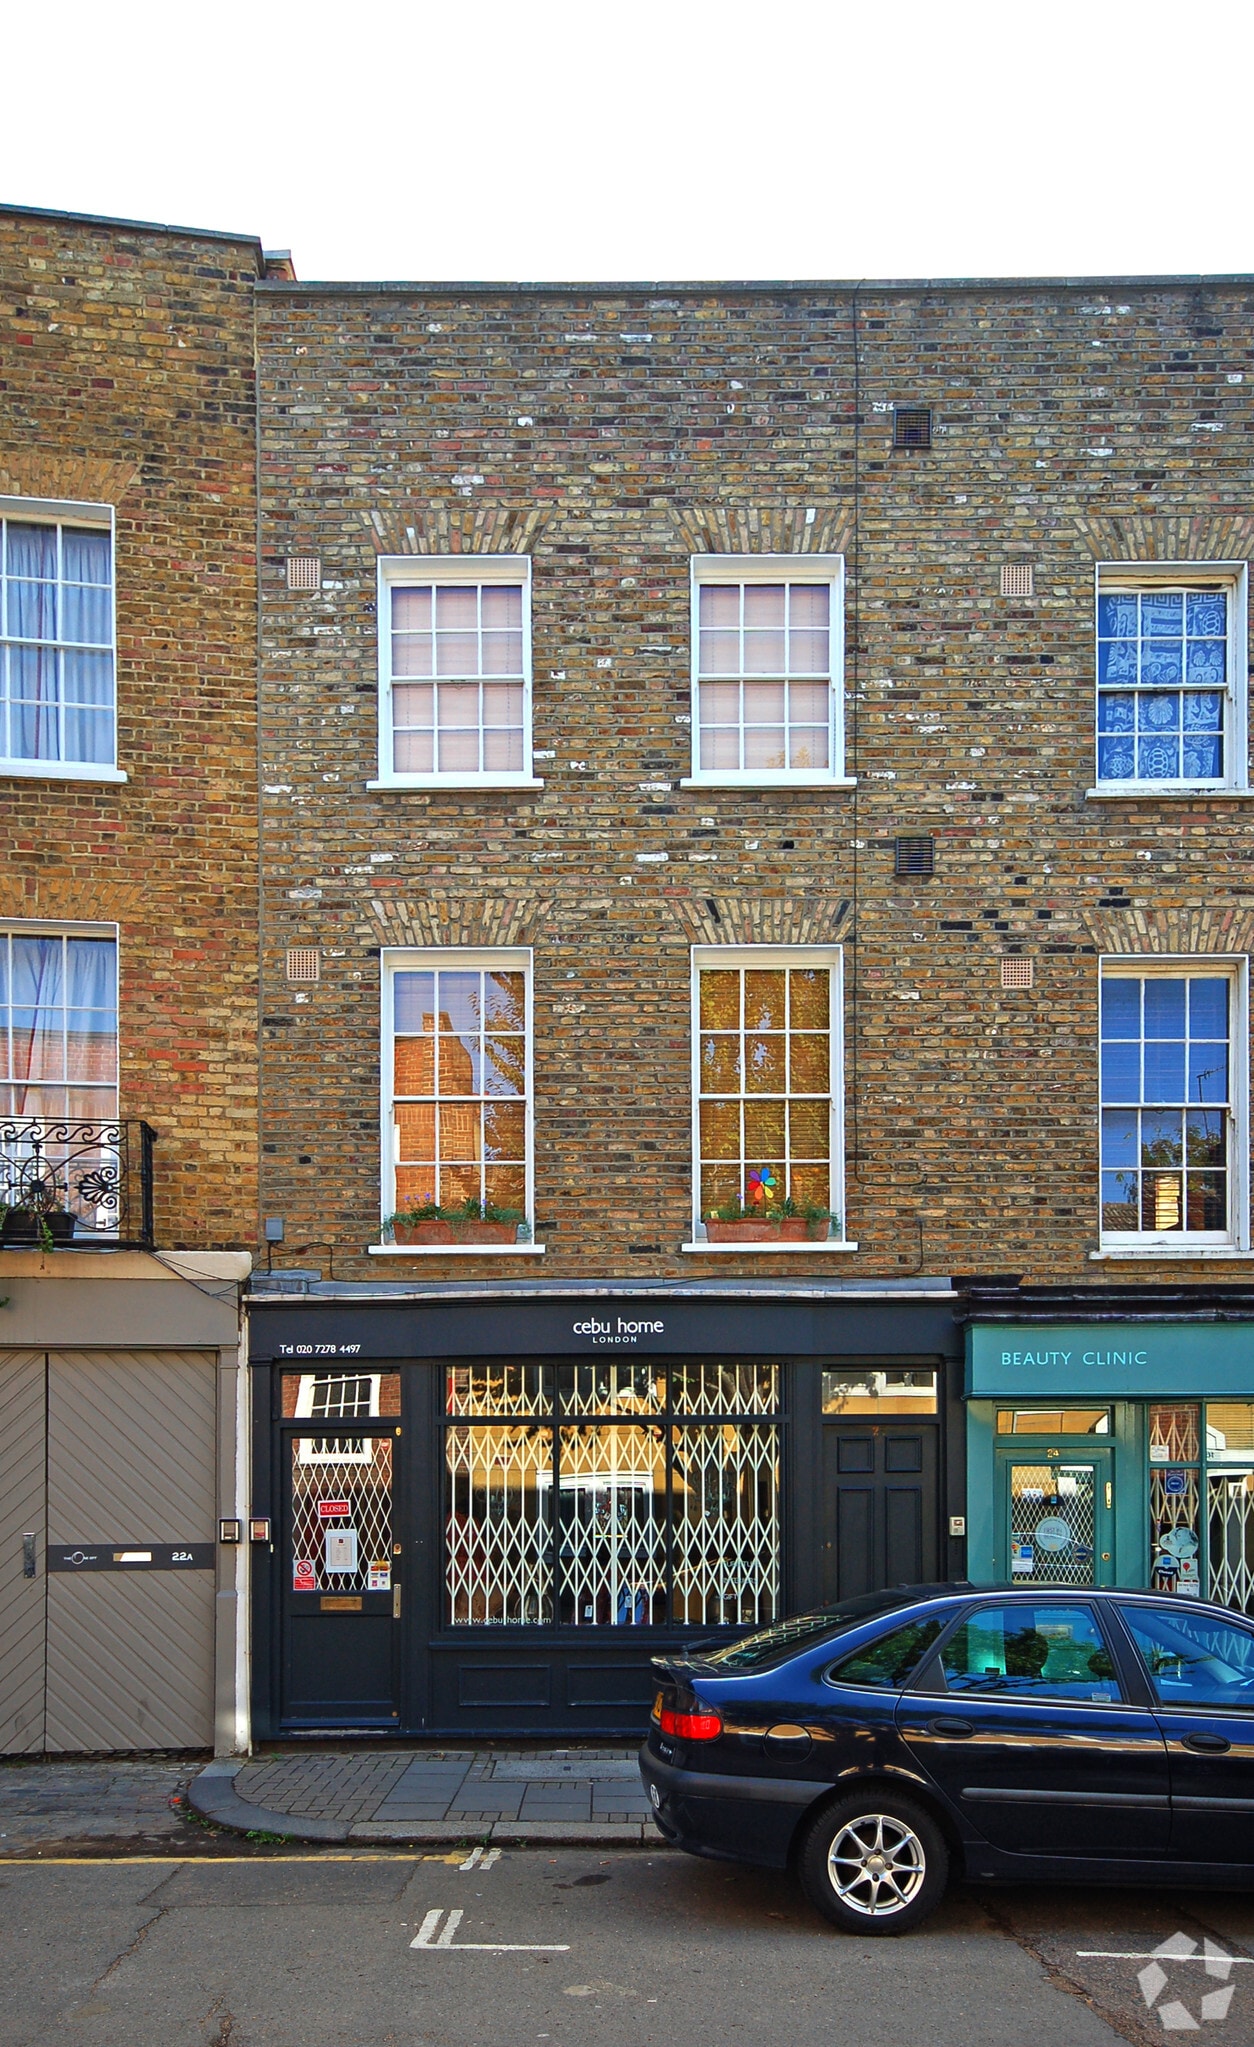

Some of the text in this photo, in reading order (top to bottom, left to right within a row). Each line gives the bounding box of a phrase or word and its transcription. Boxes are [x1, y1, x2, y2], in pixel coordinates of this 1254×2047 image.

[573, 1317, 665, 1334] cebu home
[592, 1336, 638, 1344] LONDON
[279, 1344, 361, 1354] Tel 020 7278 4497
[1001, 1351, 1149, 1366] BEAUTY CLINIC
[1046, 1448, 1060, 1459] 24
[320, 1504, 349, 1513] CLOSED
[171, 1551, 194, 1562] 22A
